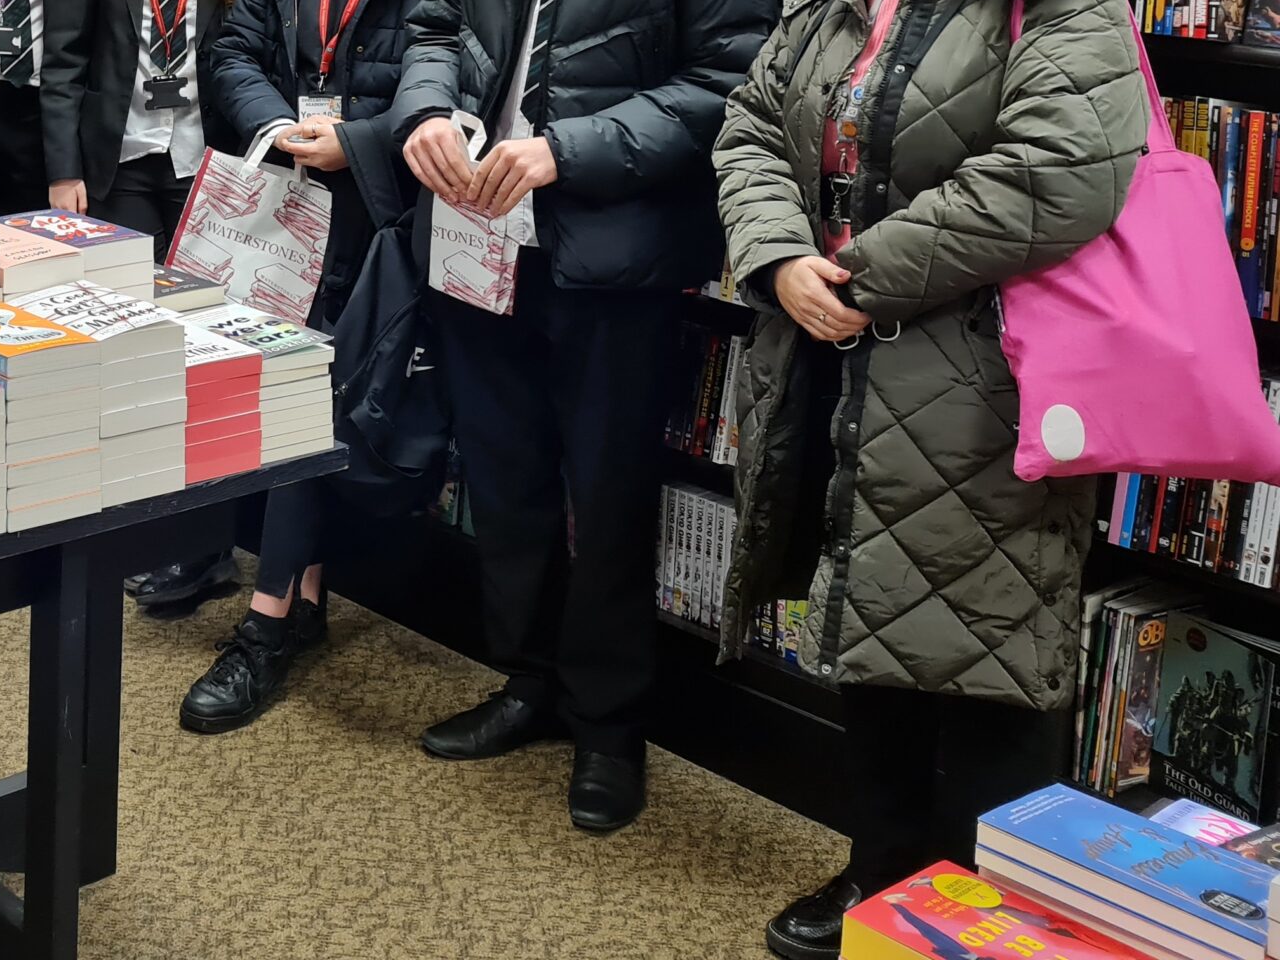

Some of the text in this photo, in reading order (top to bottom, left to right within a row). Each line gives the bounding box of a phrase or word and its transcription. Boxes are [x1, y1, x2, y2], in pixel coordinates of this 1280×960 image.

[36, 215, 70, 227] ACE
[57, 222, 78, 230] OF
[205, 220, 305, 265] WATERSTONES
[432, 224, 484, 250] STONES
[50, 290, 95, 306] Good
[86, 305, 160, 331] Murder
[208, 317, 251, 329] we
[224, 319, 282, 339] were
[1163, 764, 1250, 821] THE OLD GUARD
